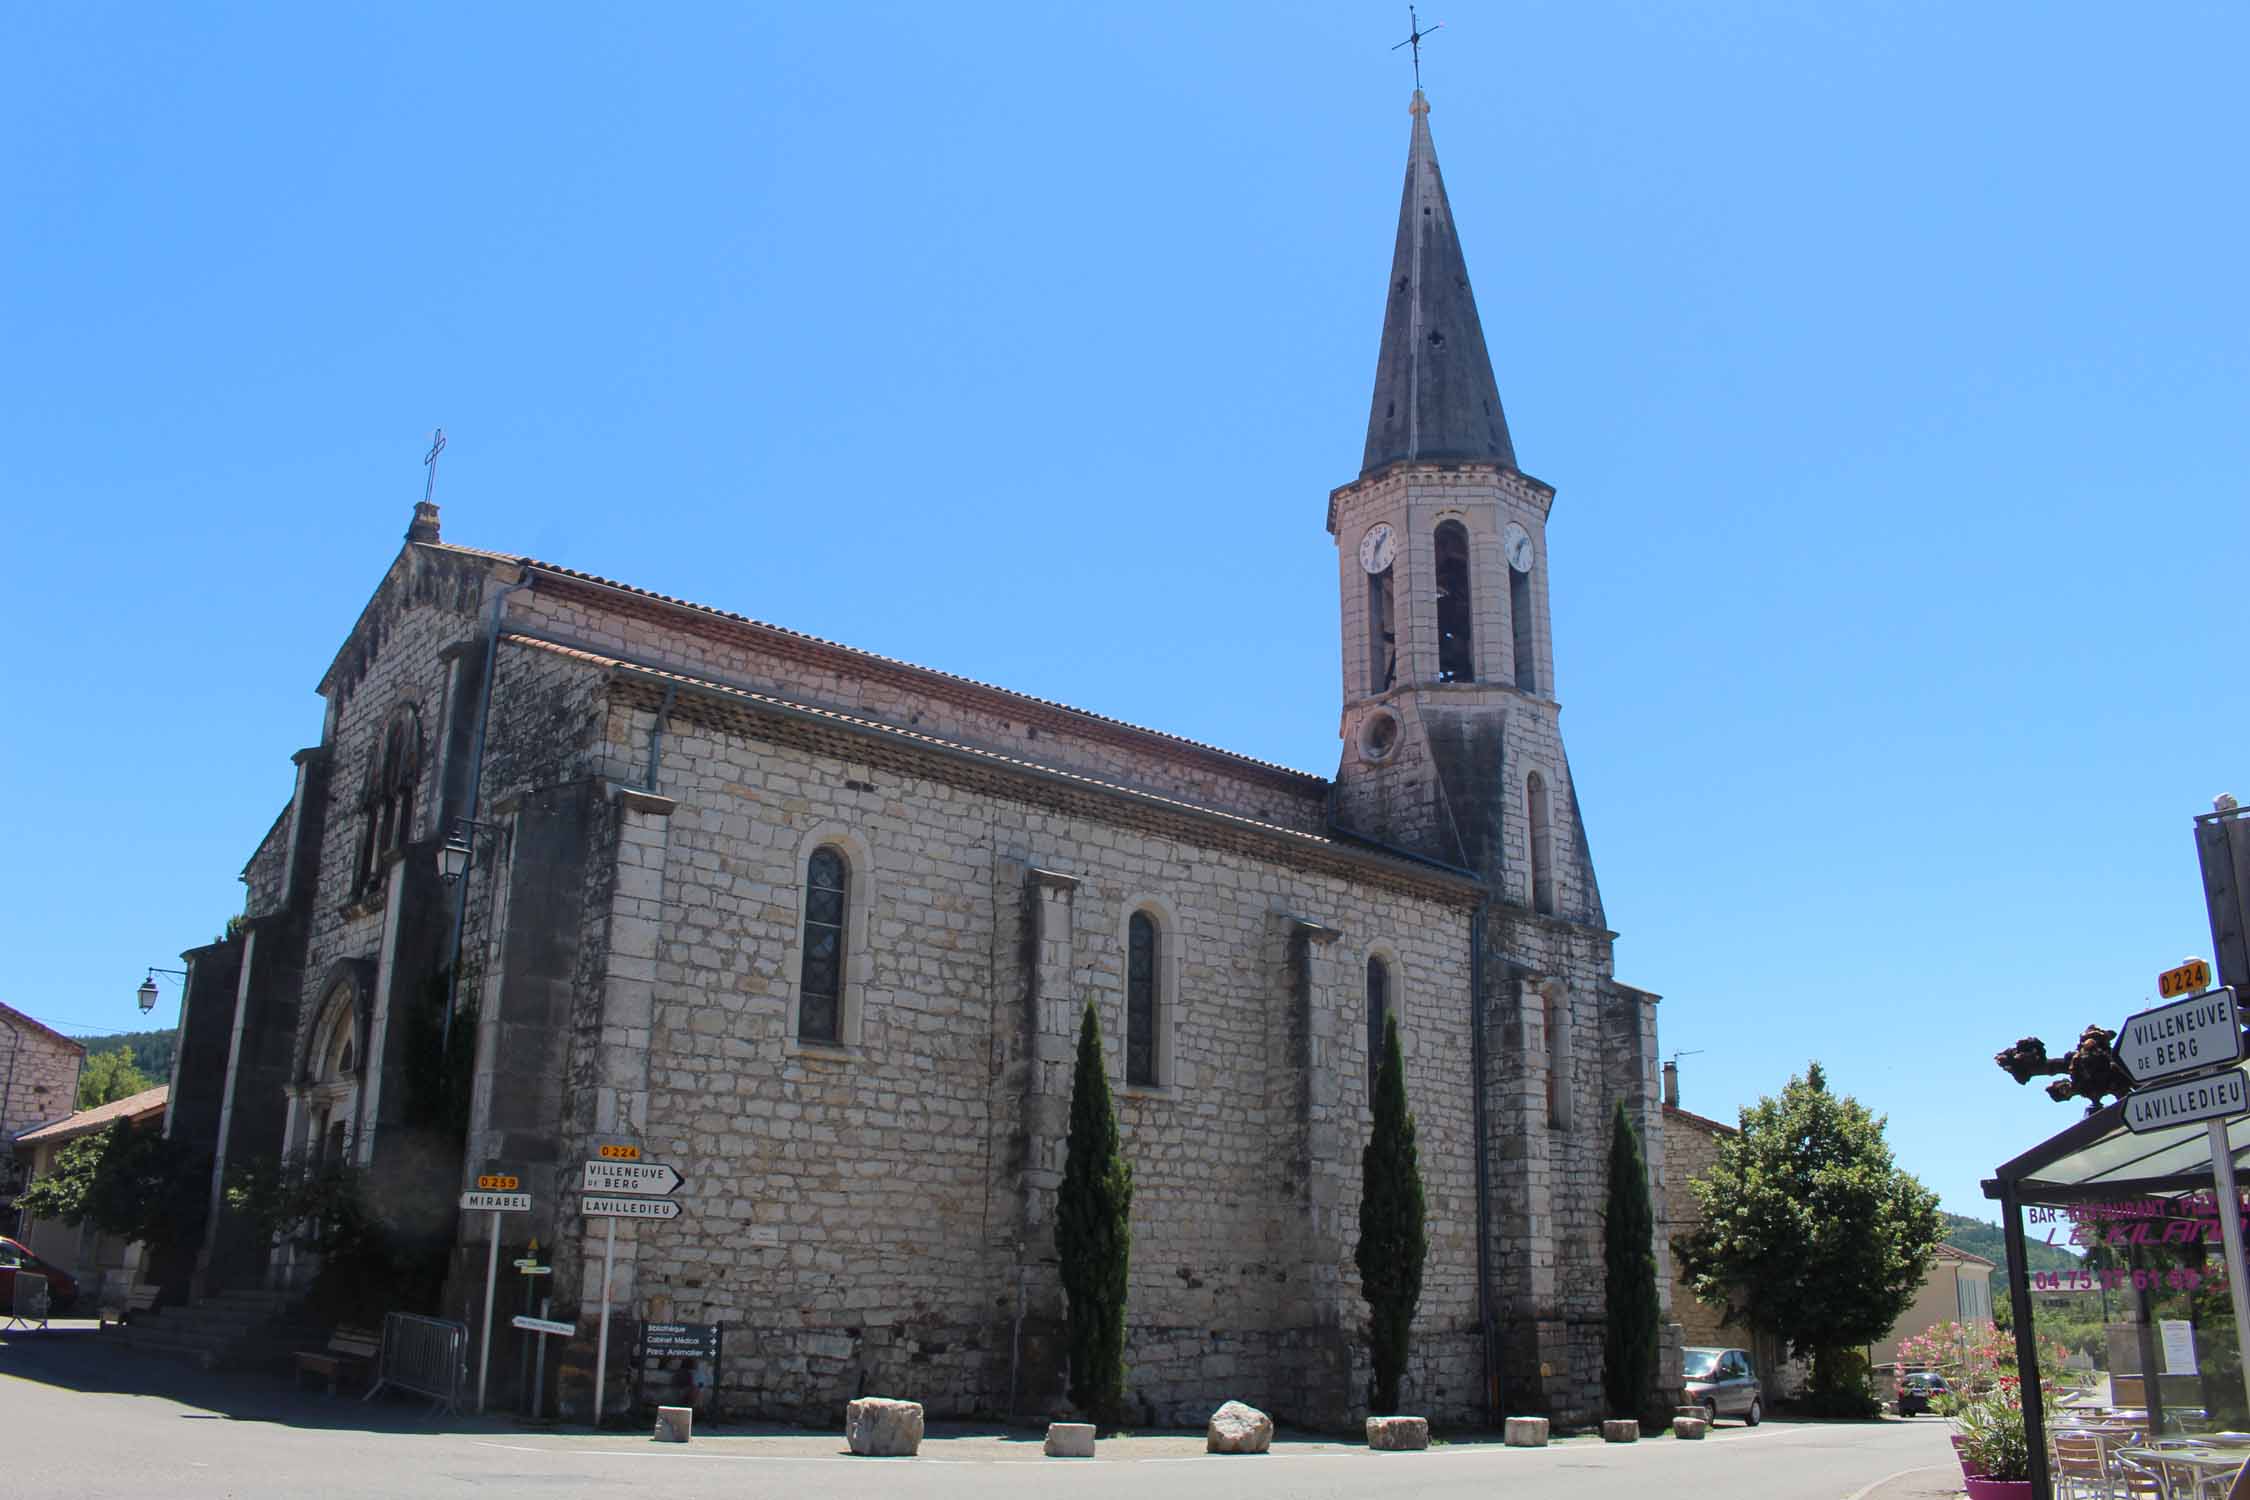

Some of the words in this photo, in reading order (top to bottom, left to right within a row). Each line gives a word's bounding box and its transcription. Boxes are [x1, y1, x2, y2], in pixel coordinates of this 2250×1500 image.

[2174, 965, 2204, 991] 224
[2134, 1003, 2228, 1046] VILLENEUVE
[2138, 1056, 2151, 1070] DE
[2157, 1038, 2199, 1067] BERG
[2135, 1081, 2240, 1122] LAVILLEDIEU
[589, 1165, 665, 1179] VILLENEUVE
[604, 1178, 639, 1189] BERG
[469, 1196, 527, 1208] MIRABEL
[585, 1202, 670, 1215] LAVILLEDIEU
[2029, 1207, 2057, 1224] BAR
[2035, 1270, 2060, 1290] 04
[2065, 1270, 2092, 1290] 75
[647, 1335, 673, 1343] Cabinet
